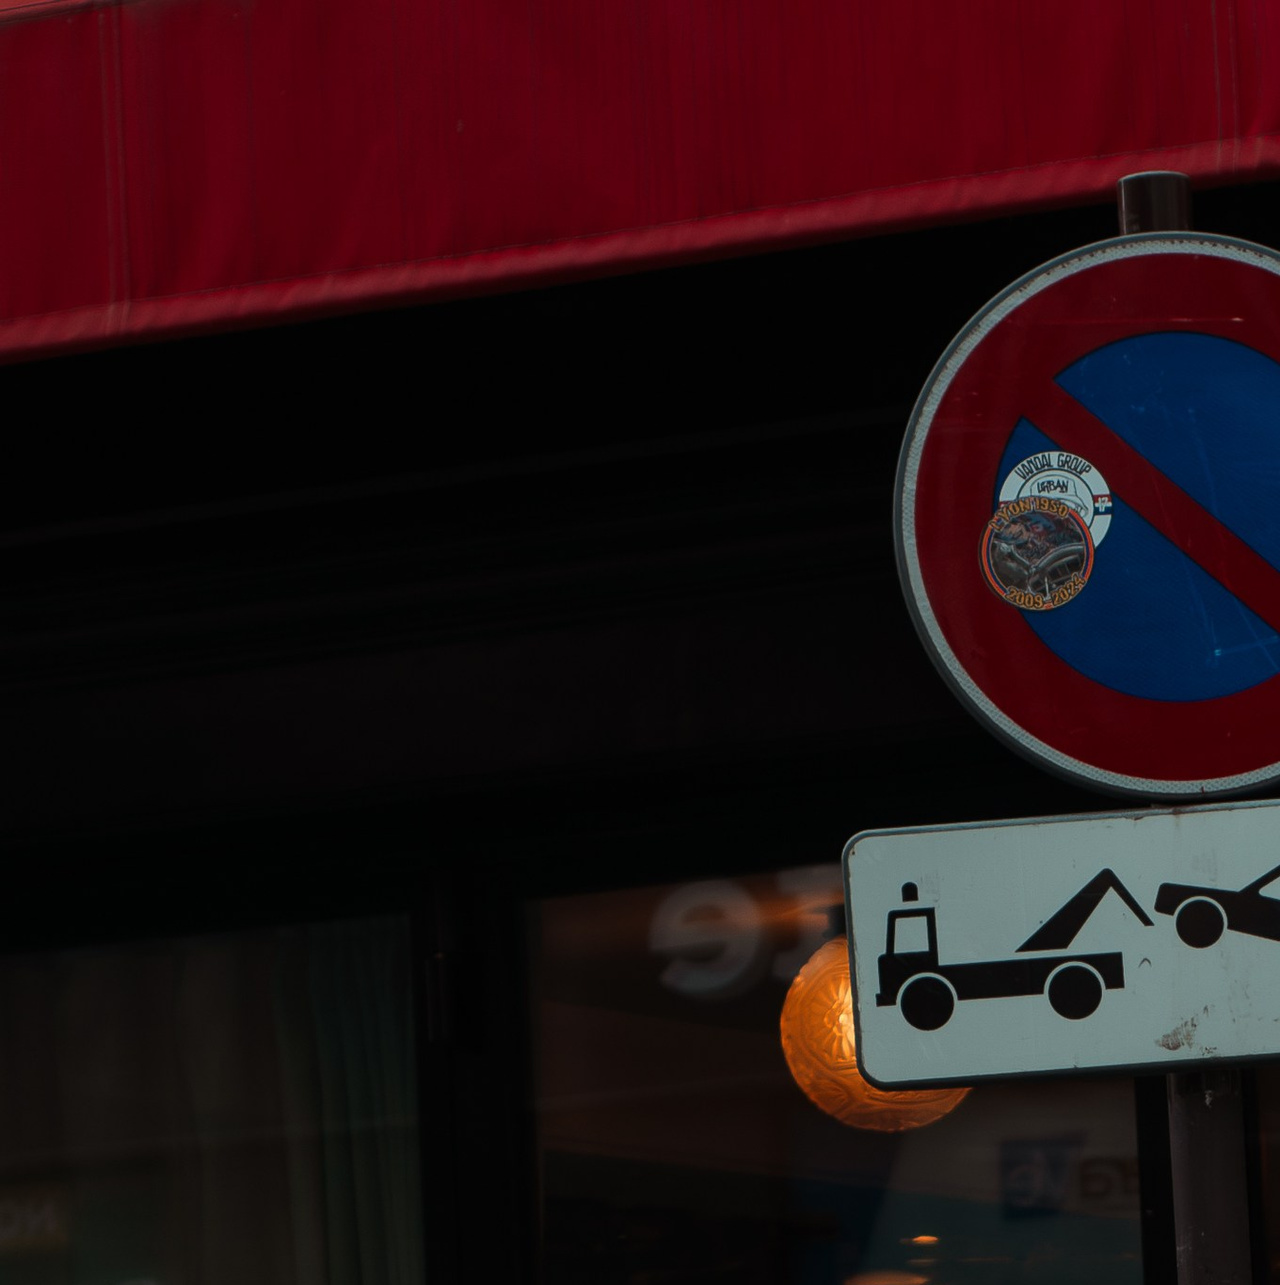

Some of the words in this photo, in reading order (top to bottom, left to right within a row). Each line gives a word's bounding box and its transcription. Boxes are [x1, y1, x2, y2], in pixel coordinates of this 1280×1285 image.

[1015, 453, 1053, 480] VANDAL
[1057, 453, 1092, 475] GROUP
[1034, 497, 1068, 518] 1950
[1005, 585, 1043, 608] 2009
[1051, 573, 1084, 605] 2024
